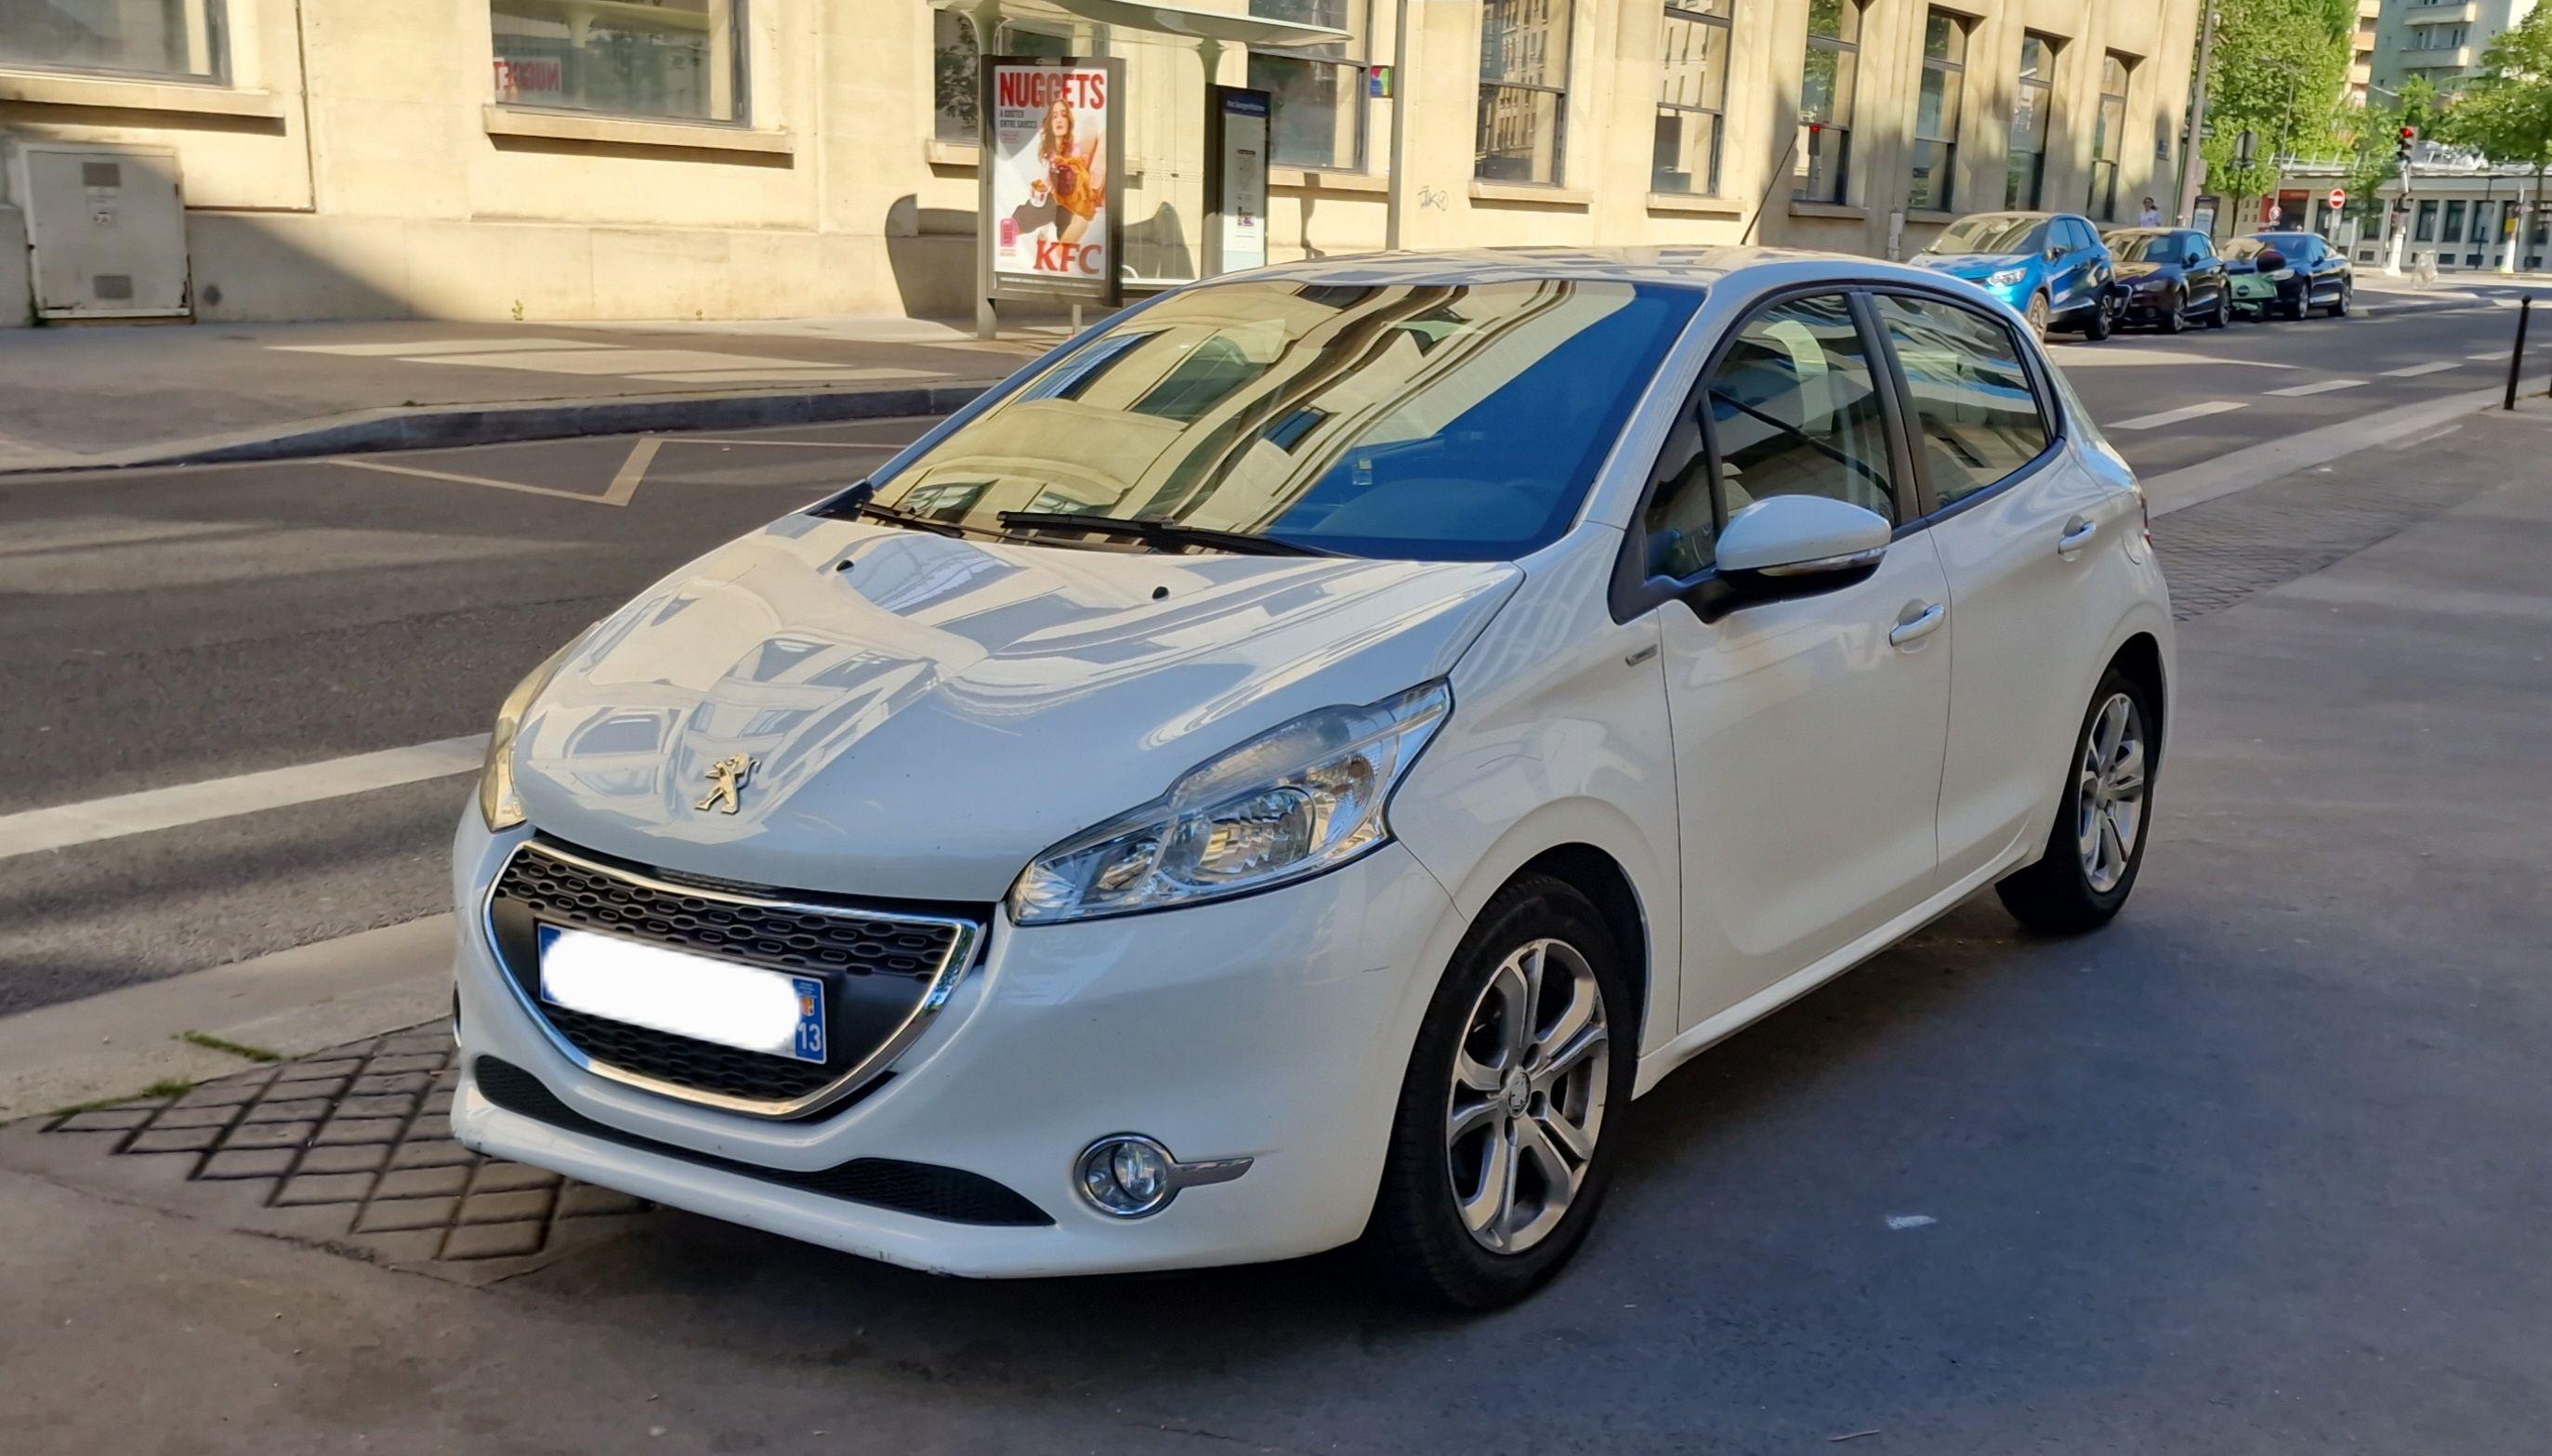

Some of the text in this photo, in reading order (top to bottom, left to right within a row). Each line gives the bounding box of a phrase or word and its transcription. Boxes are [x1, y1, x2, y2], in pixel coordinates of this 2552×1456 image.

[999, 72, 1105, 110] NUGGETS
[1033, 239, 1103, 275] KFC
[797, 1022, 822, 1052] 13
